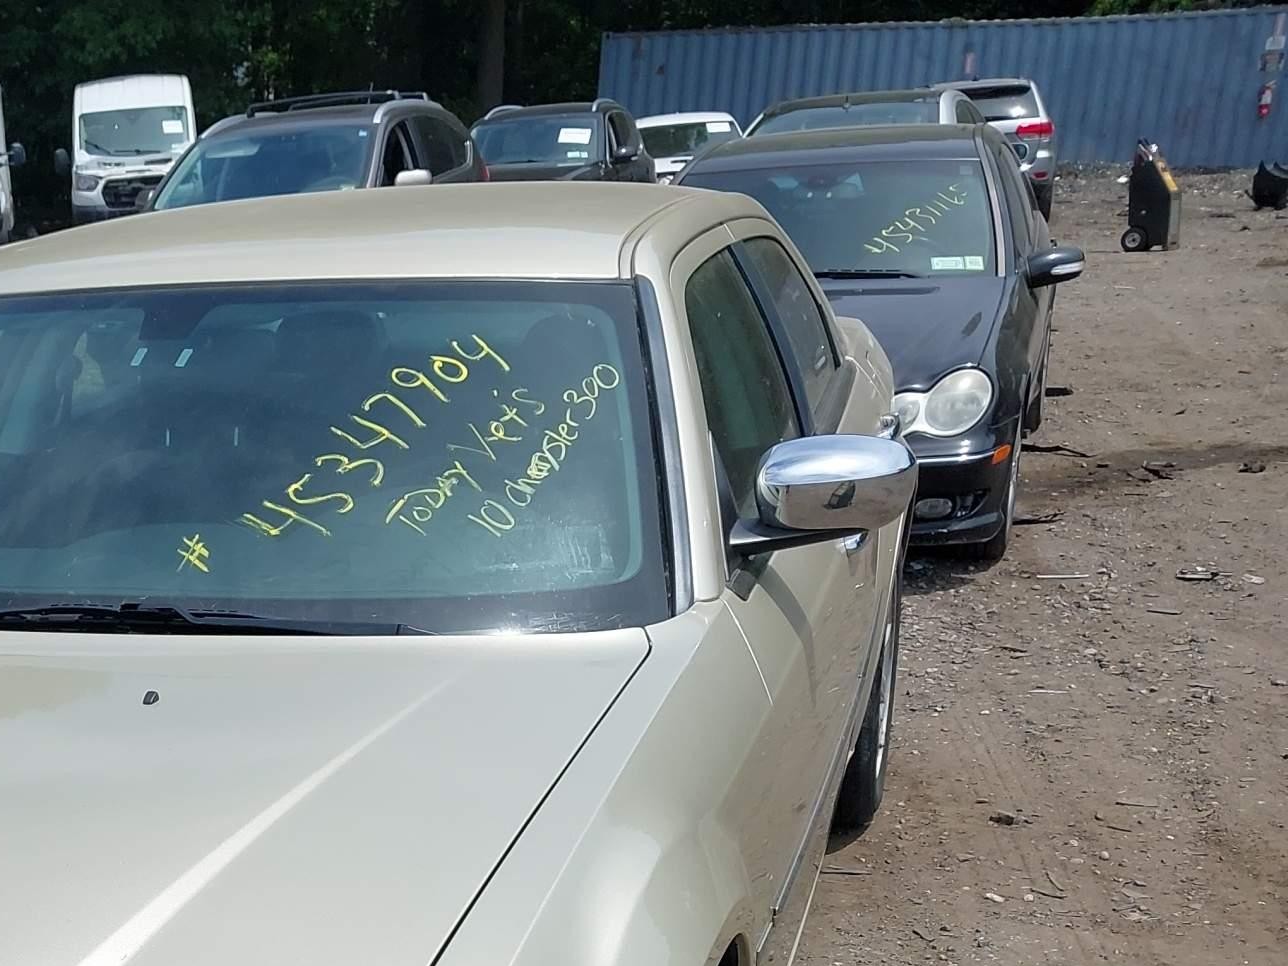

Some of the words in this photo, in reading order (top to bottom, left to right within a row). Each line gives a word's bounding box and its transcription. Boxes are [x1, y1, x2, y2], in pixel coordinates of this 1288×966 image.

[176, 532, 210, 574] #
[238, 334, 511, 537] 45347904
[467, 499, 517, 538] 10
[504, 407, 580, 508] Chysler
[562, 362, 621, 421] 300
